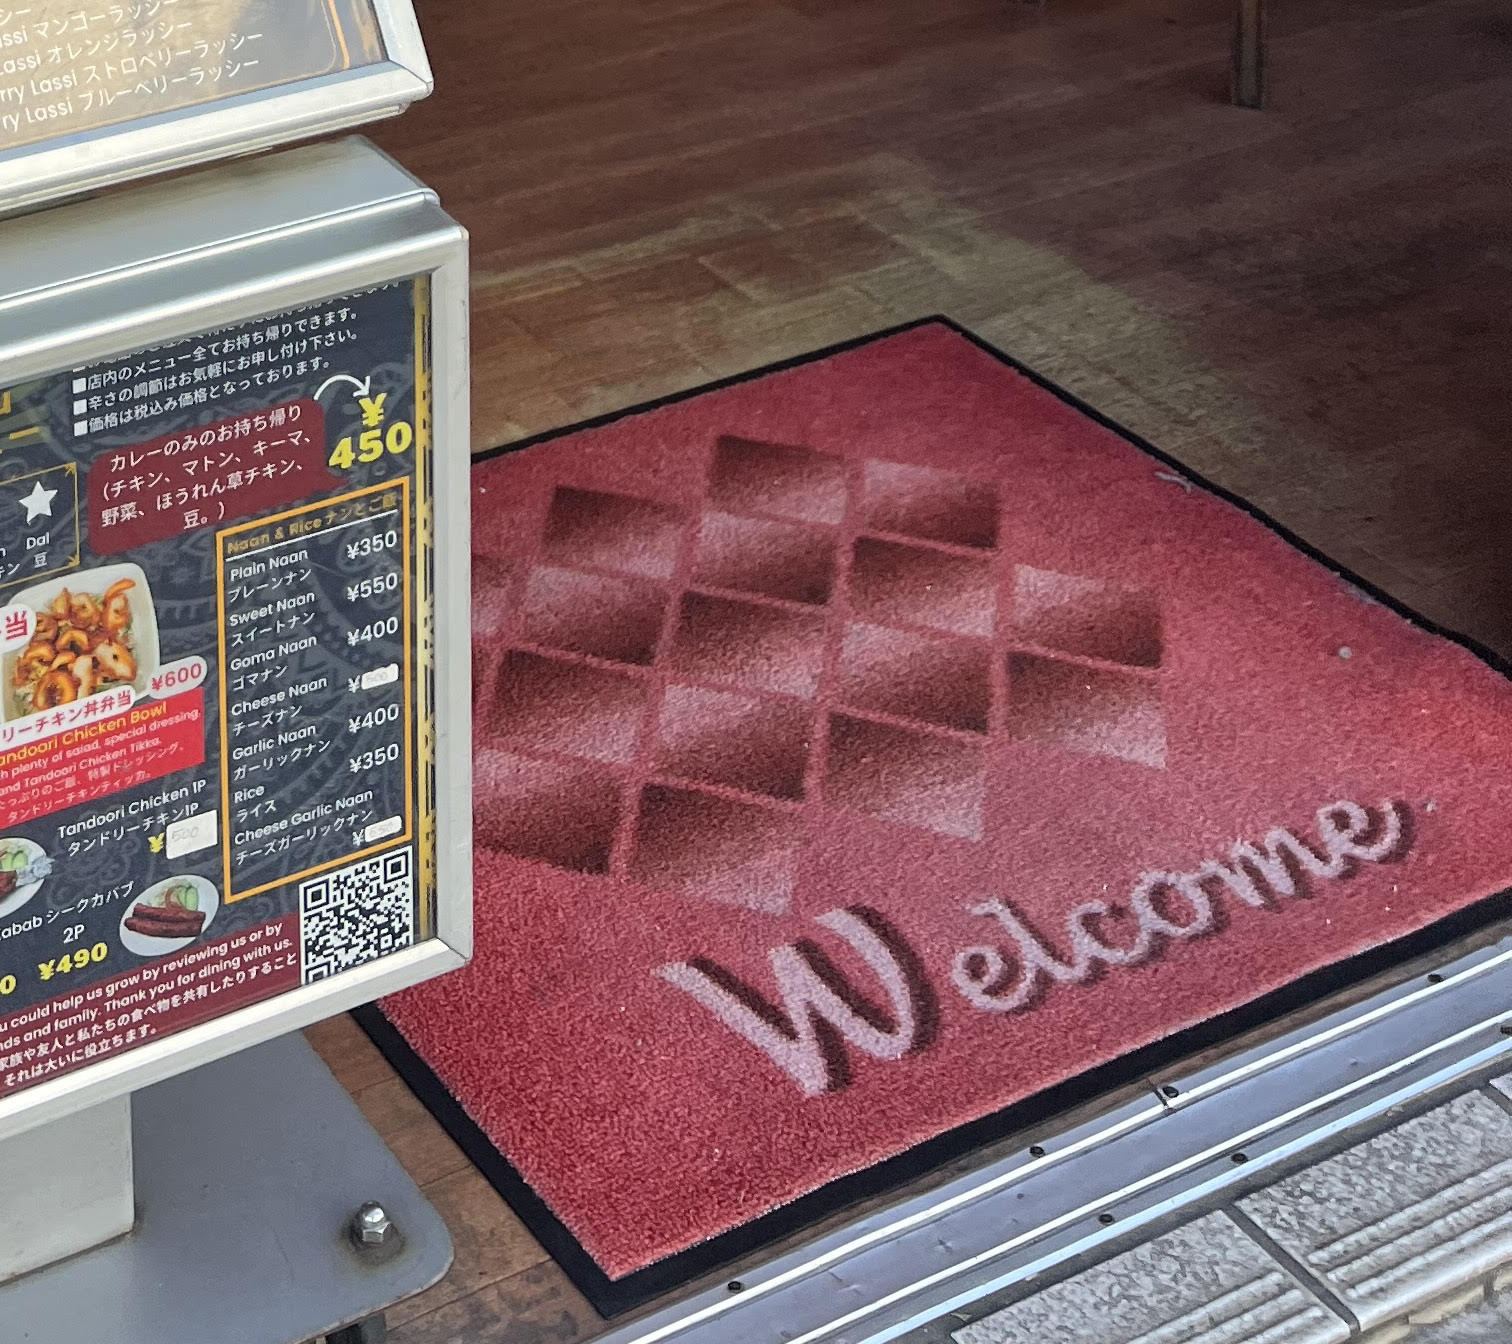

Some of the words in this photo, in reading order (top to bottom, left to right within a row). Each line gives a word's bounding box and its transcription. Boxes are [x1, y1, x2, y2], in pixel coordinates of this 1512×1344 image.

[30, 70, 77, 96] Lassi
[86, 34, 264, 84] ストロベリーラッシー
[110, 405, 302, 473] カレーのみのお持ち帰り
[329, 422, 412, 469] 450
[230, 560, 265, 581] Plain
[269, 548, 308, 569] Naan
[346, 530, 397, 558] ¥350
[230, 602, 273, 627] Sweet
[276, 590, 315, 612] Naan
[347, 573, 398, 601] ¥550
[47, 880, 135, 922] シークカバブ
[38, 943, 108, 982] ¥490
[659, 798, 1406, 1096] Welcome
